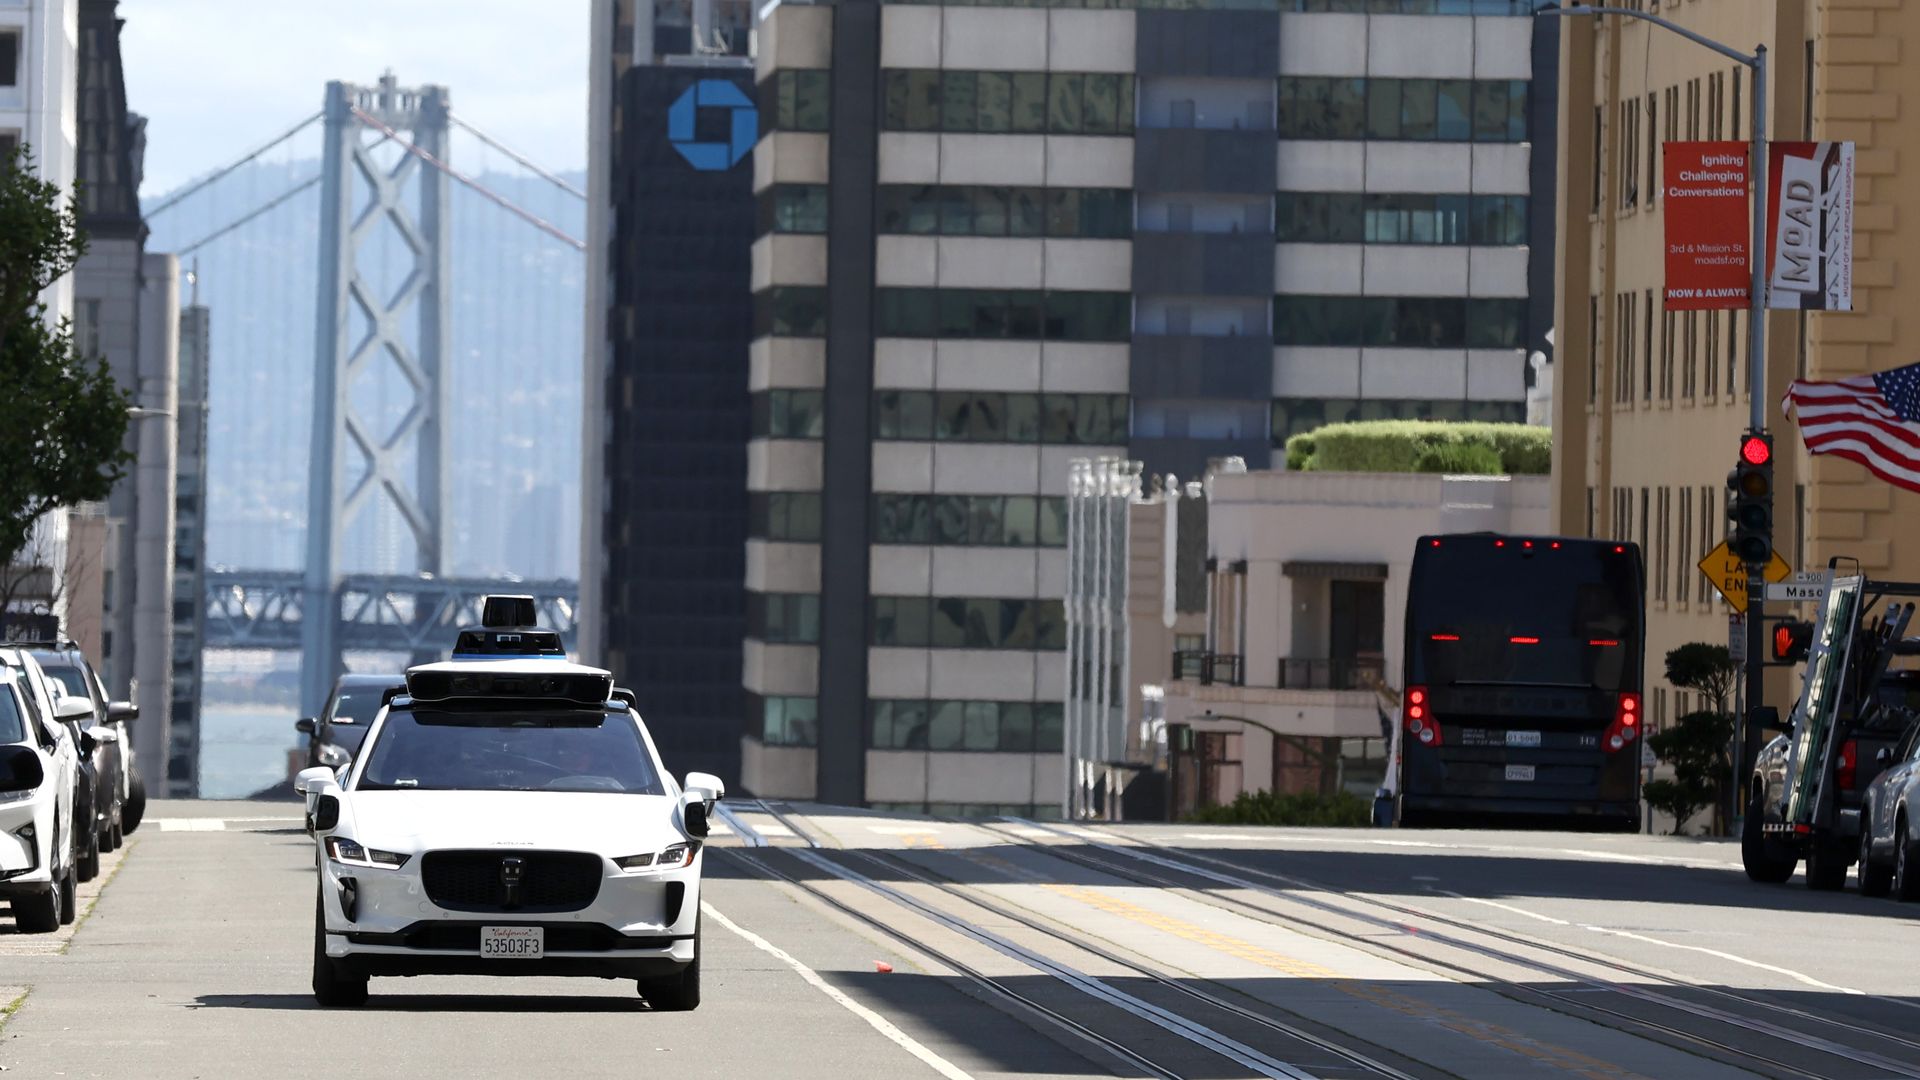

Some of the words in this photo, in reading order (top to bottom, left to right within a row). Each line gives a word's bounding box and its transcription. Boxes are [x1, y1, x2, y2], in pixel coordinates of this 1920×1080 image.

[1701, 154, 1744, 167] Igniting
[1680, 170, 1744, 183] Challenging
[1669, 186, 1745, 197] Conversations
[1670, 244, 1685, 254] 3rd
[1687, 244, 1695, 253] &
[1697, 243, 1731, 253] Mission
[1732, 243, 1745, 253] St.
[1694, 255, 1745, 266] moadsf.org
[1843, 252, 1850, 263] OF
[1668, 289, 1694, 298] NOW
[1695, 289, 1704, 298] &
[1705, 288, 1747, 297] ALWAYS
[1786, 586, 1823, 598] Maso
[494, 928, 529, 938] California
[485, 938, 540, 954] 53503F3
